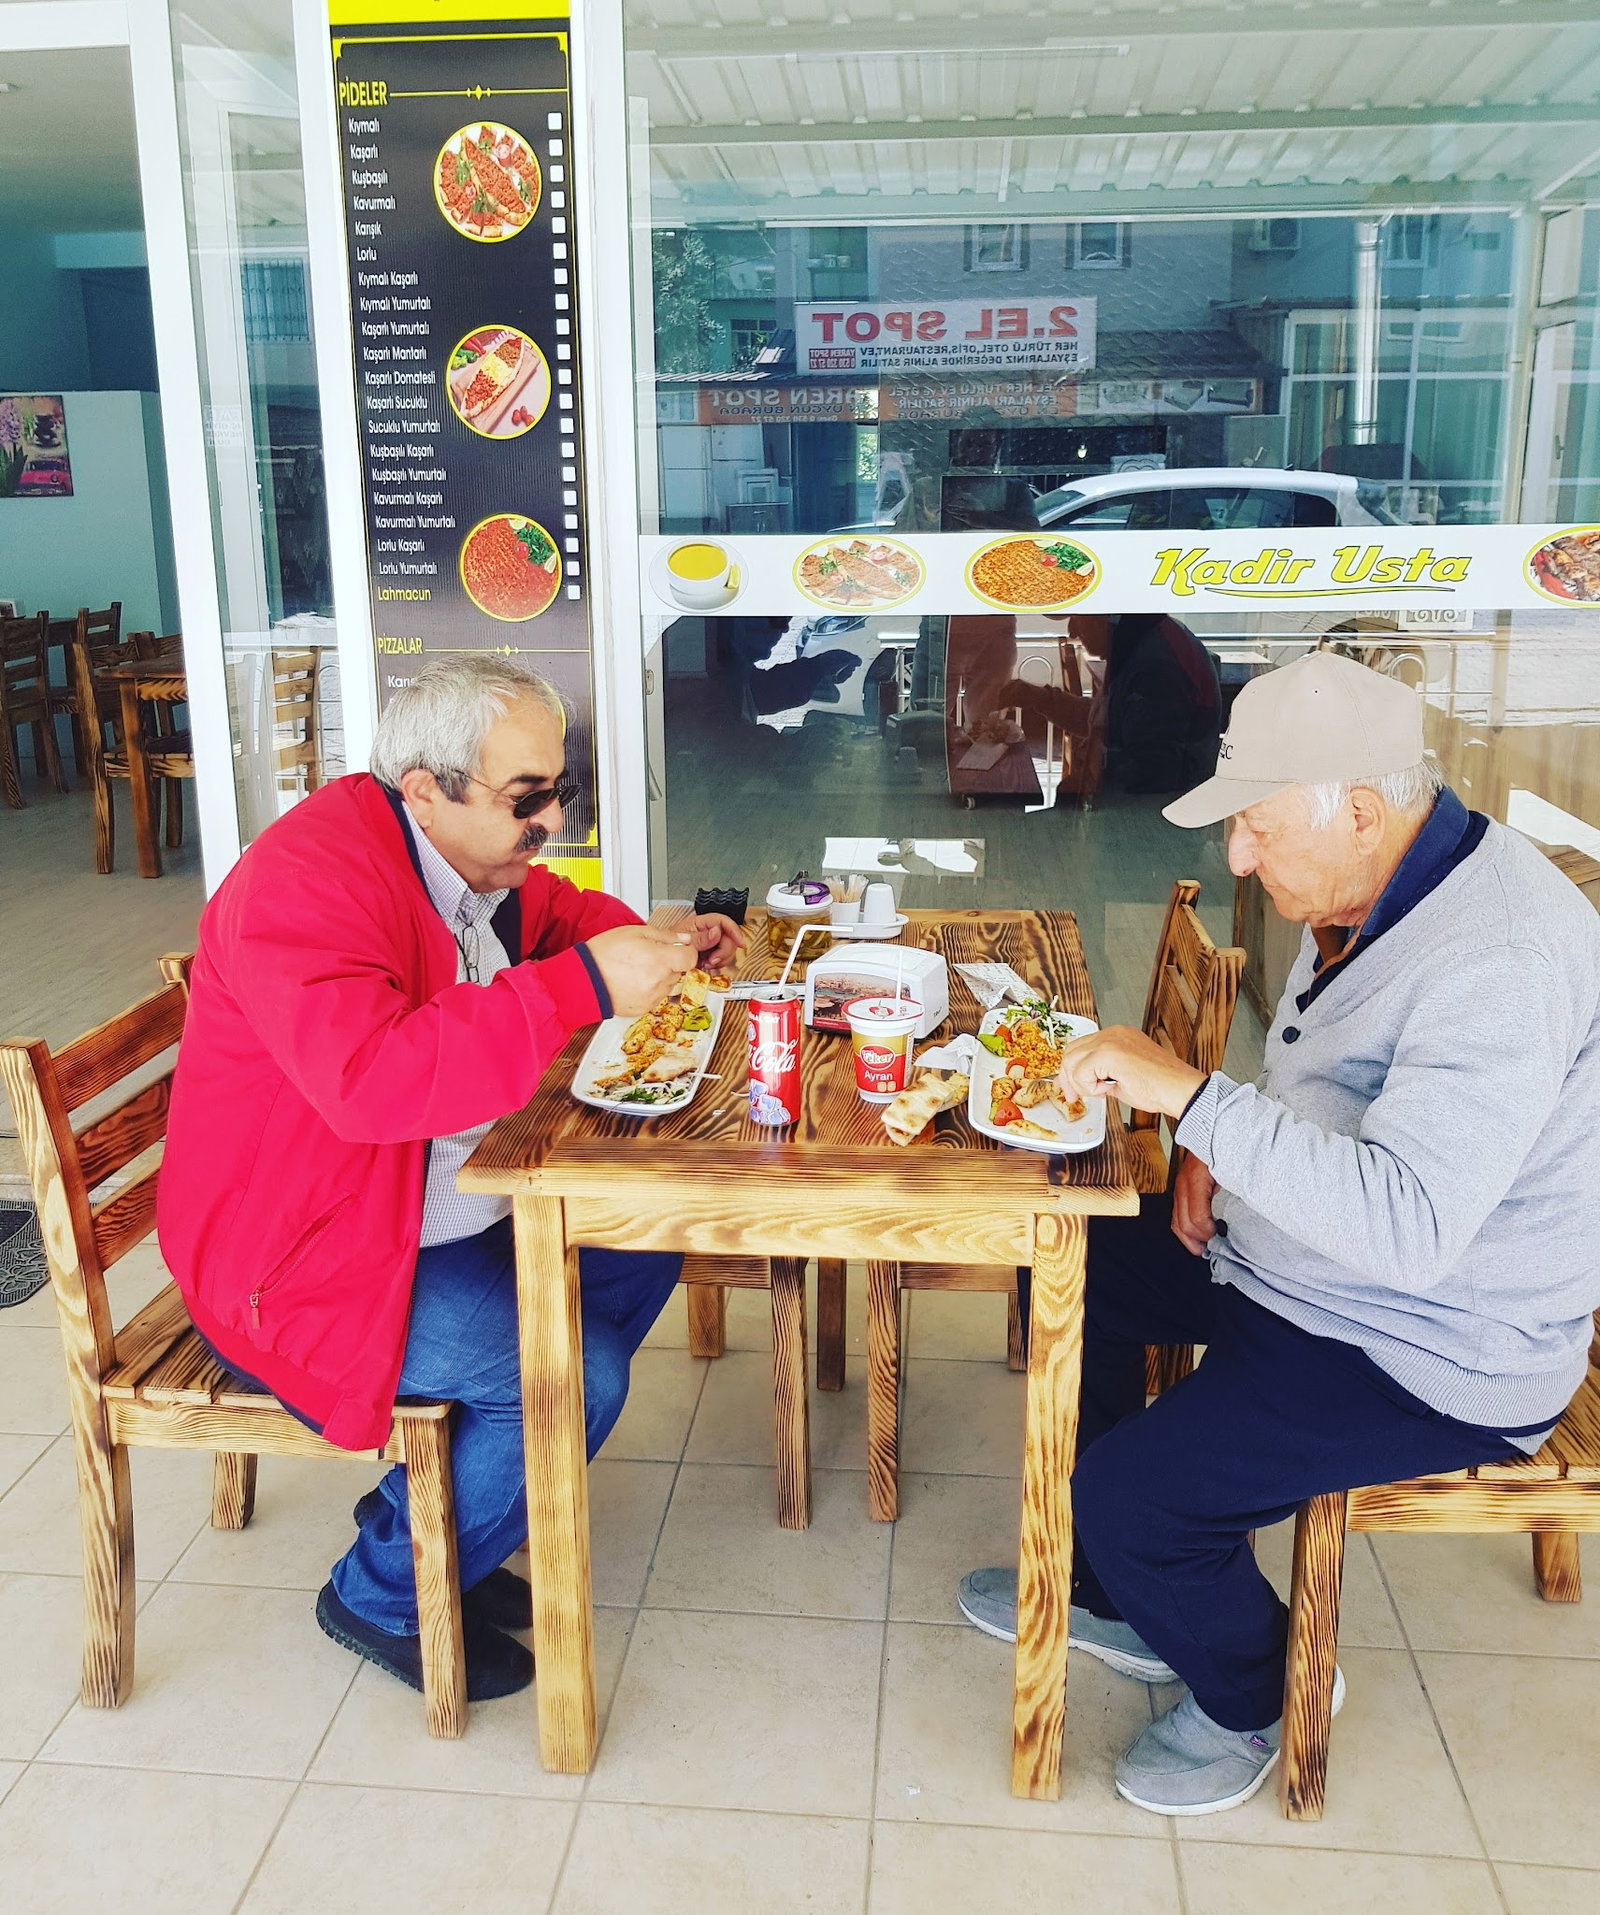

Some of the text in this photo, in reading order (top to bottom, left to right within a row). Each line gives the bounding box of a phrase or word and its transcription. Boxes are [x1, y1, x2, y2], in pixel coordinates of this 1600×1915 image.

[339, 77, 388, 106] PİDELER
[349, 117, 380, 136] Kıymalı
[350, 143, 379, 163] Kaşarlı
[352, 169, 388, 189] Kuşbaşılı
[353, 195, 396, 210] Kavurmalı
[355, 221, 382, 240] Karışık
[357, 247, 377, 261] Lorlu
[358, 271, 418, 289] Kıymalı Kaşarlı
[360, 295, 431, 313] Kıymalı Yumurtalı
[361, 321, 430, 339] Kaşarlı Yumurtalı
[363, 346, 427, 364] Kaşarlı Mantarlı
[365, 371, 436, 388] Kaşarlı Domatesli
[367, 396, 428, 413] Kaşarlı Sucuklu
[368, 420, 441, 434] Sucuklu Yumurtalı
[370, 444, 434, 461] Kuşbaşılı Kaşarlı
[372, 468, 447, 485] Kuşbaşılı Yumurtalı
[373, 492, 443, 509] Kavurmalı Kaşarlı
[375, 515, 456, 528] Kavurmalı Yumurtalı
[377, 539, 425, 555] Lorlu Kaşarlı
[379, 562, 438, 575] Lorlu Yumurtalı
[1150, 545, 1473, 596] Kadir Usta
[378, 586, 431, 601] Lahmacun
[378, 633, 423, 654] PİZZALAR
[864, 1070, 893, 1082] Ayran
